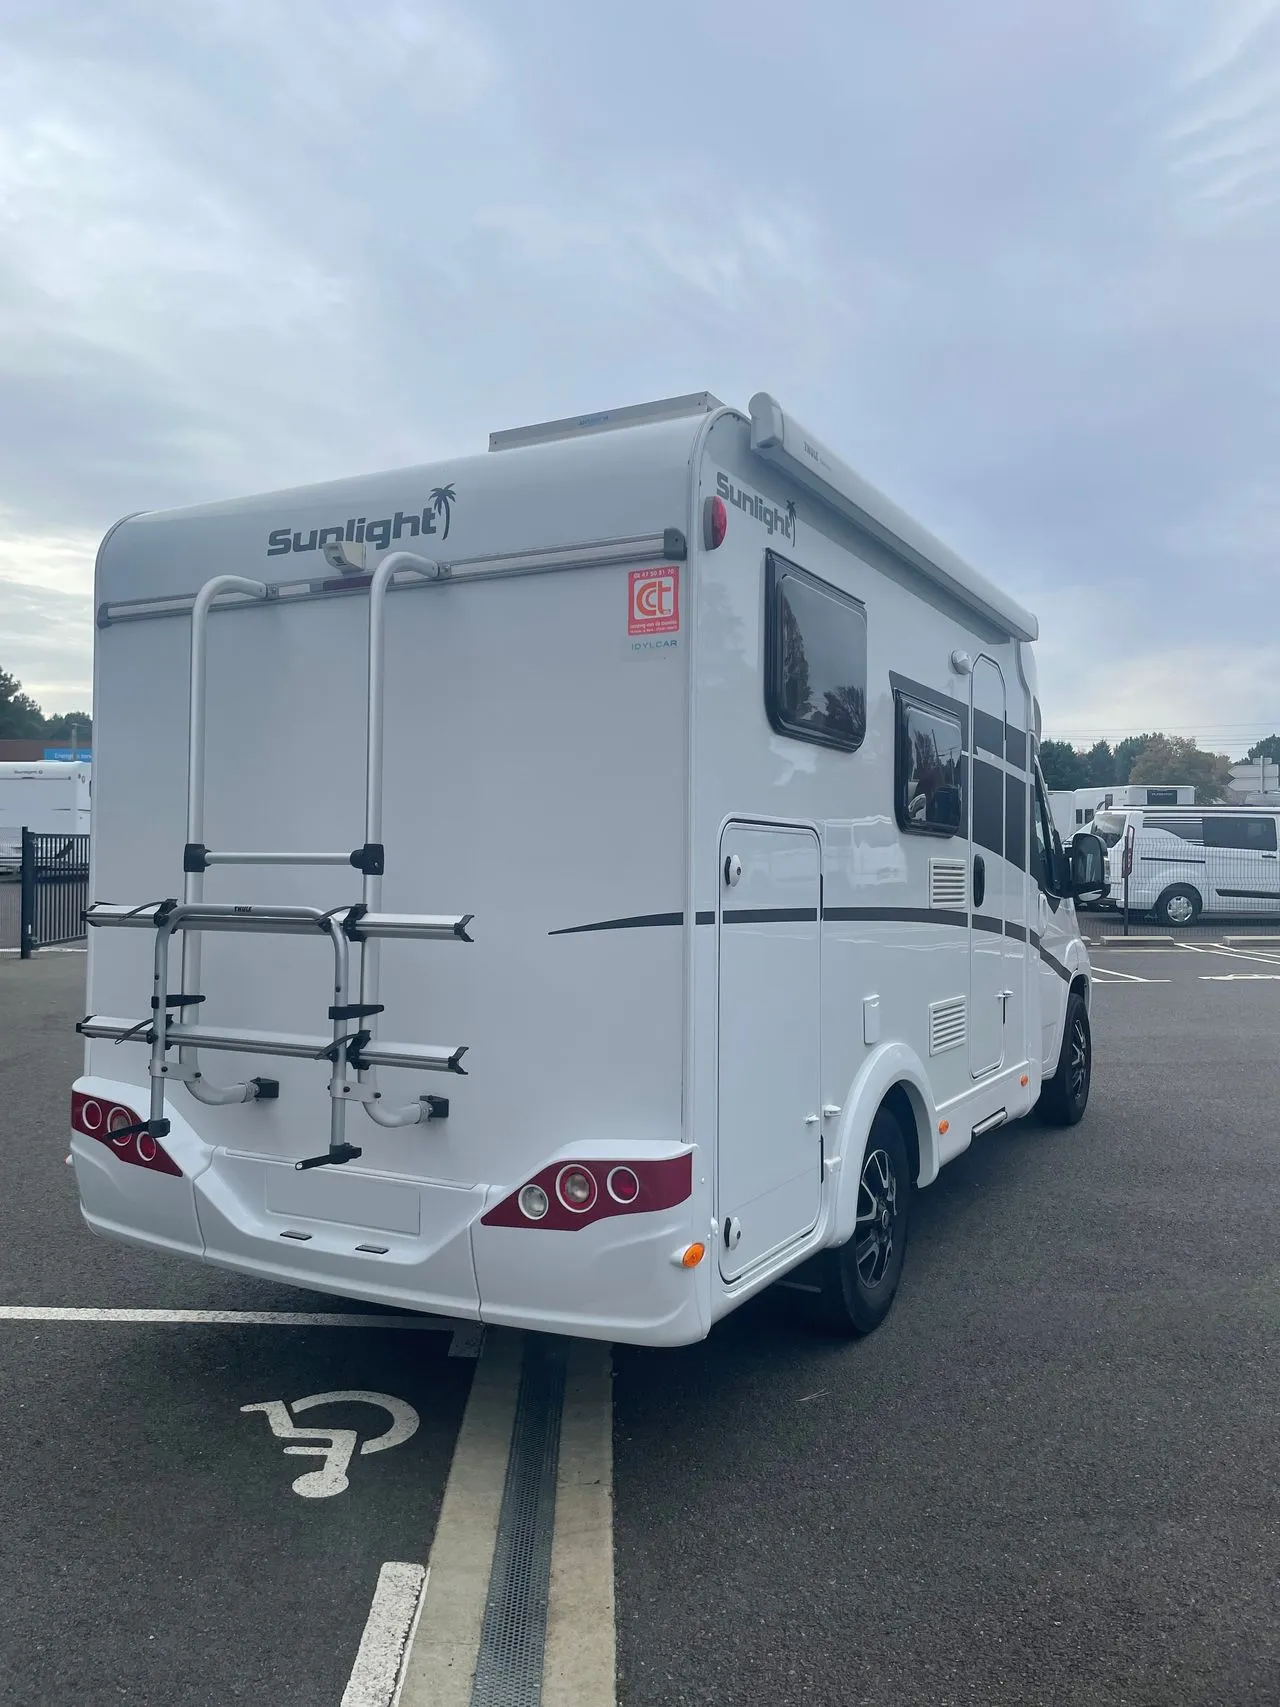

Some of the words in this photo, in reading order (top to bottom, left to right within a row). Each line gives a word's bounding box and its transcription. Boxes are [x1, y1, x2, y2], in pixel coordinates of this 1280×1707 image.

[716, 471, 791, 539] Sunlight
[267, 507, 437, 556] Sunlight
[631, 640, 677, 650] IDYLCAR
